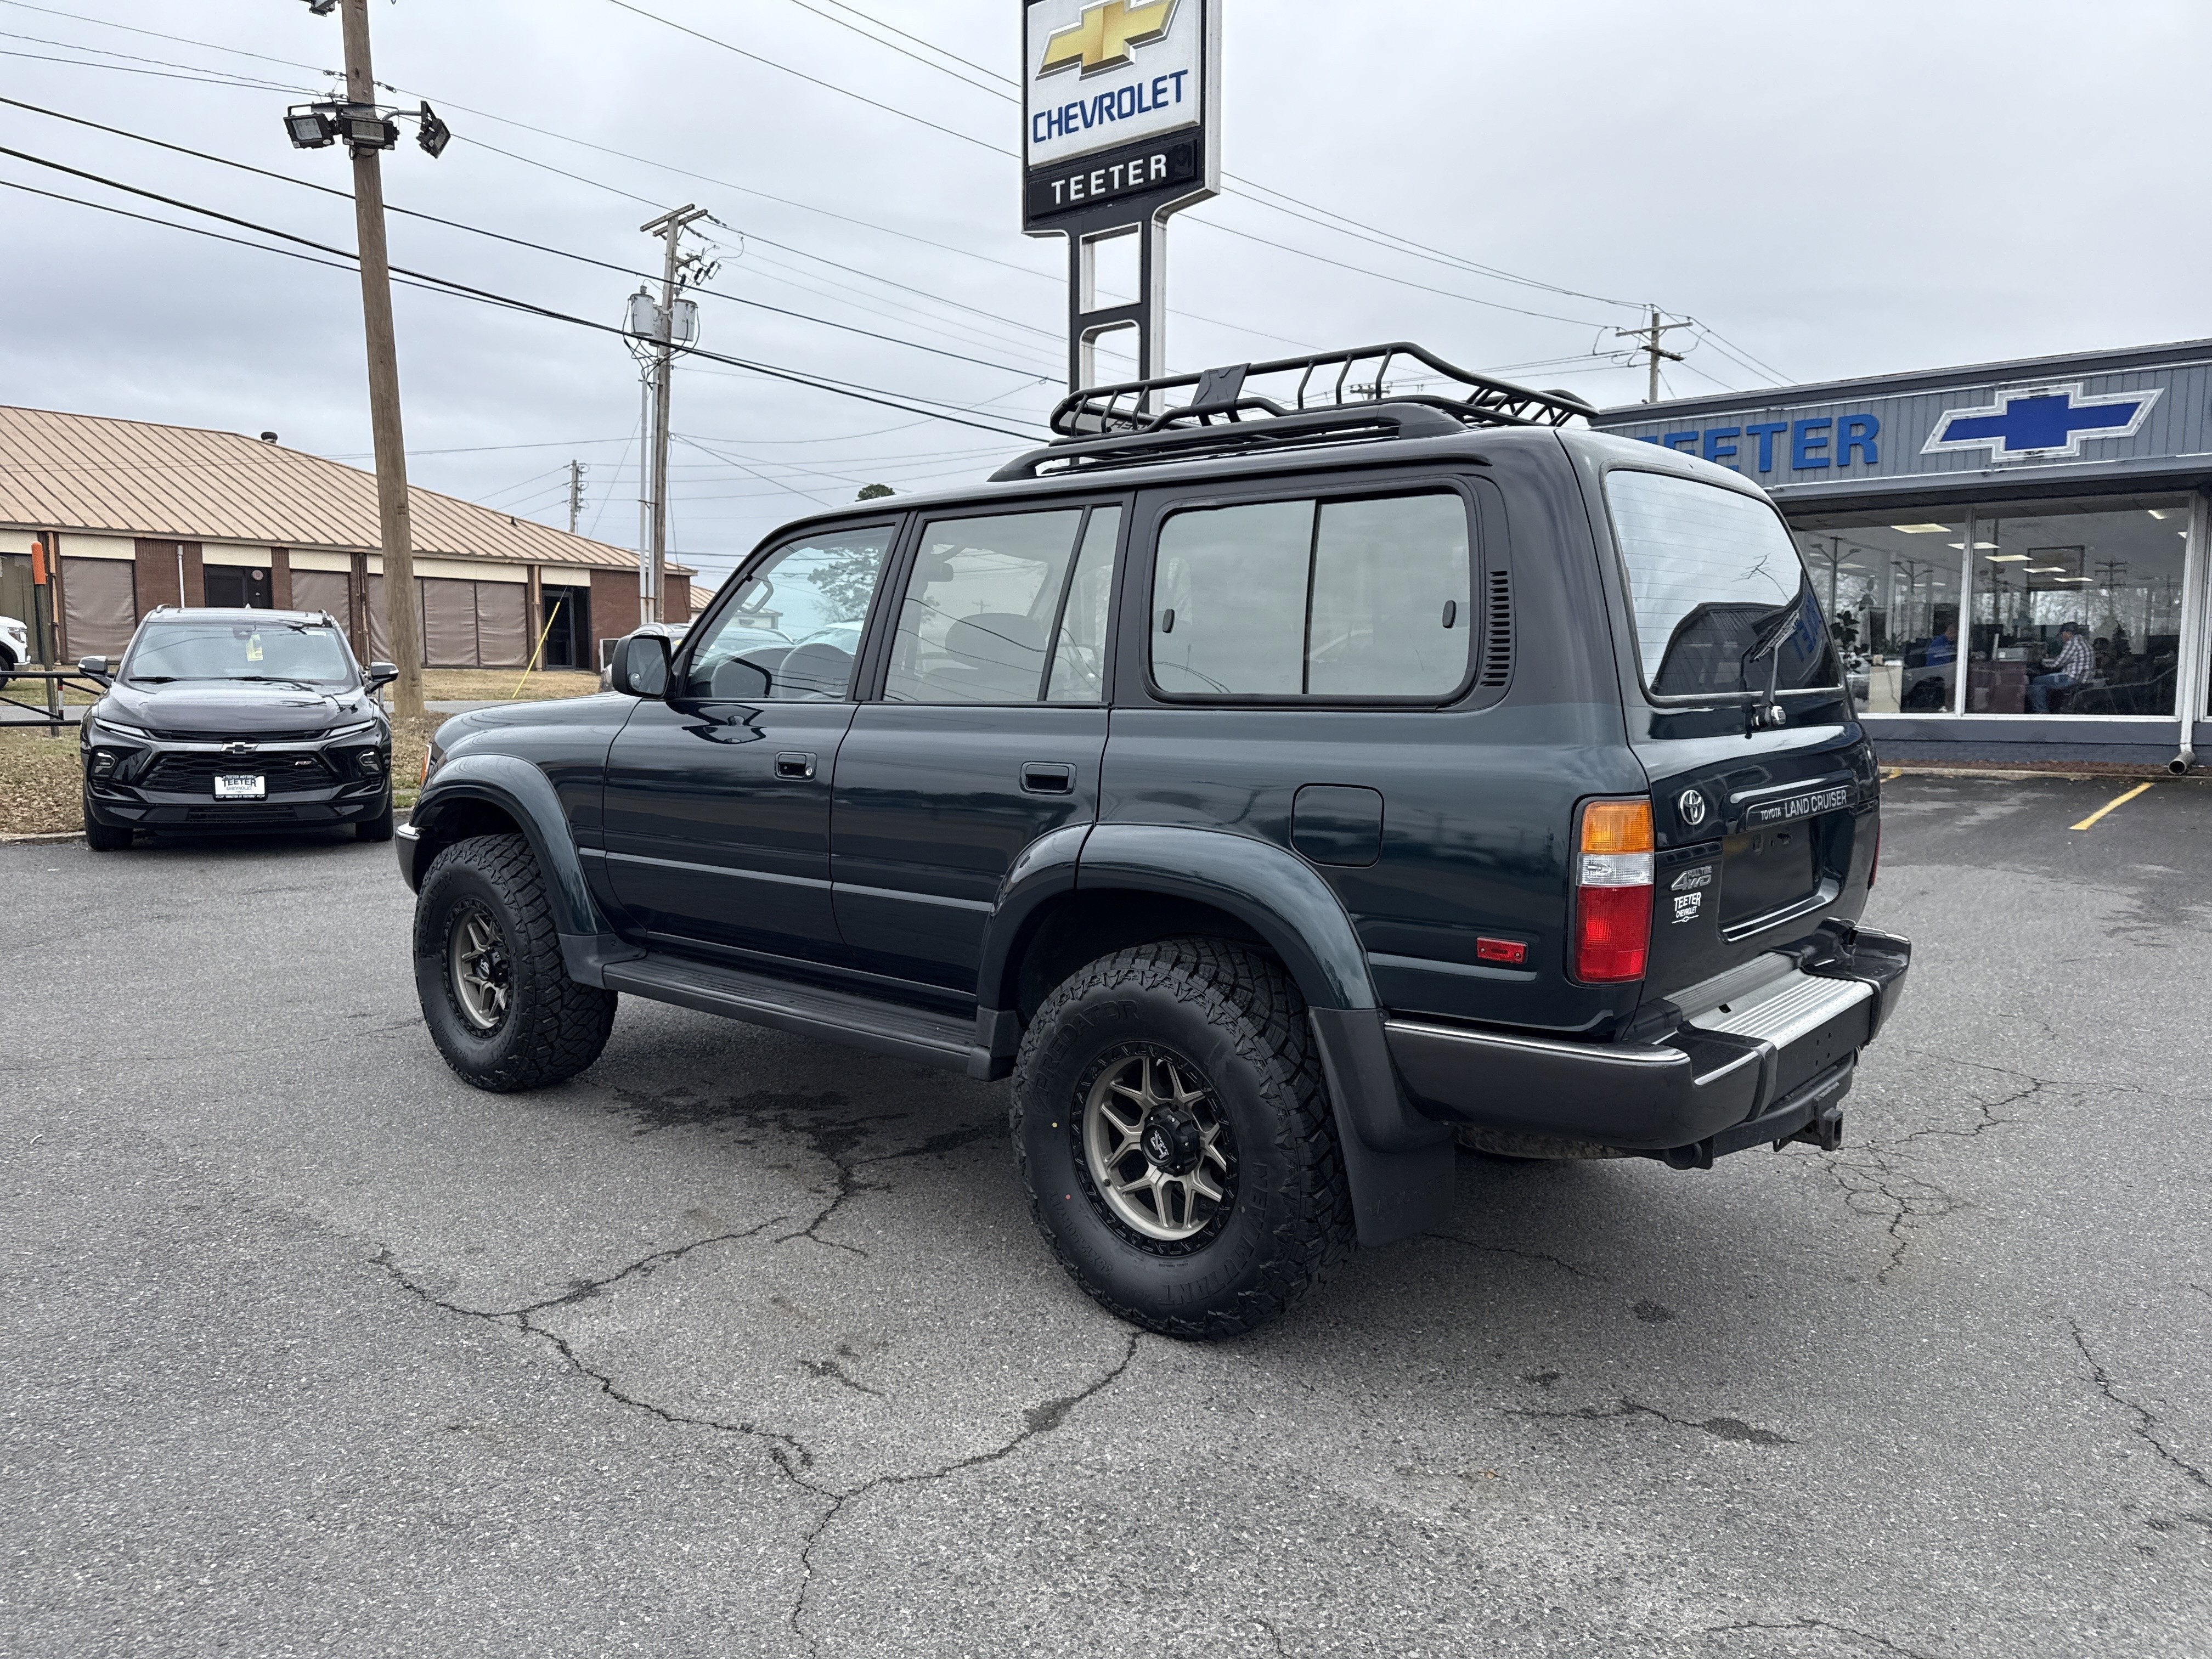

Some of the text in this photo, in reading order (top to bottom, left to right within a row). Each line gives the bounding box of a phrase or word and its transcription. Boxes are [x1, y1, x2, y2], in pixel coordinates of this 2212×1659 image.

[1033, 69, 1188, 143] CHEVROLET
[1051, 154, 1167, 205] TEETER
[1635, 413, 1880, 472] ETER
[222, 778, 257, 787] TEETER
[1760, 789, 1847, 821] TOYOTA LAND CRUISER
[1670, 871, 1712, 891] 4WD
[1674, 891, 1701, 912] TEETER
[1676, 906, 1697, 918] CHEVROLET
[1034, 1000, 1139, 1097] PREDATOR
